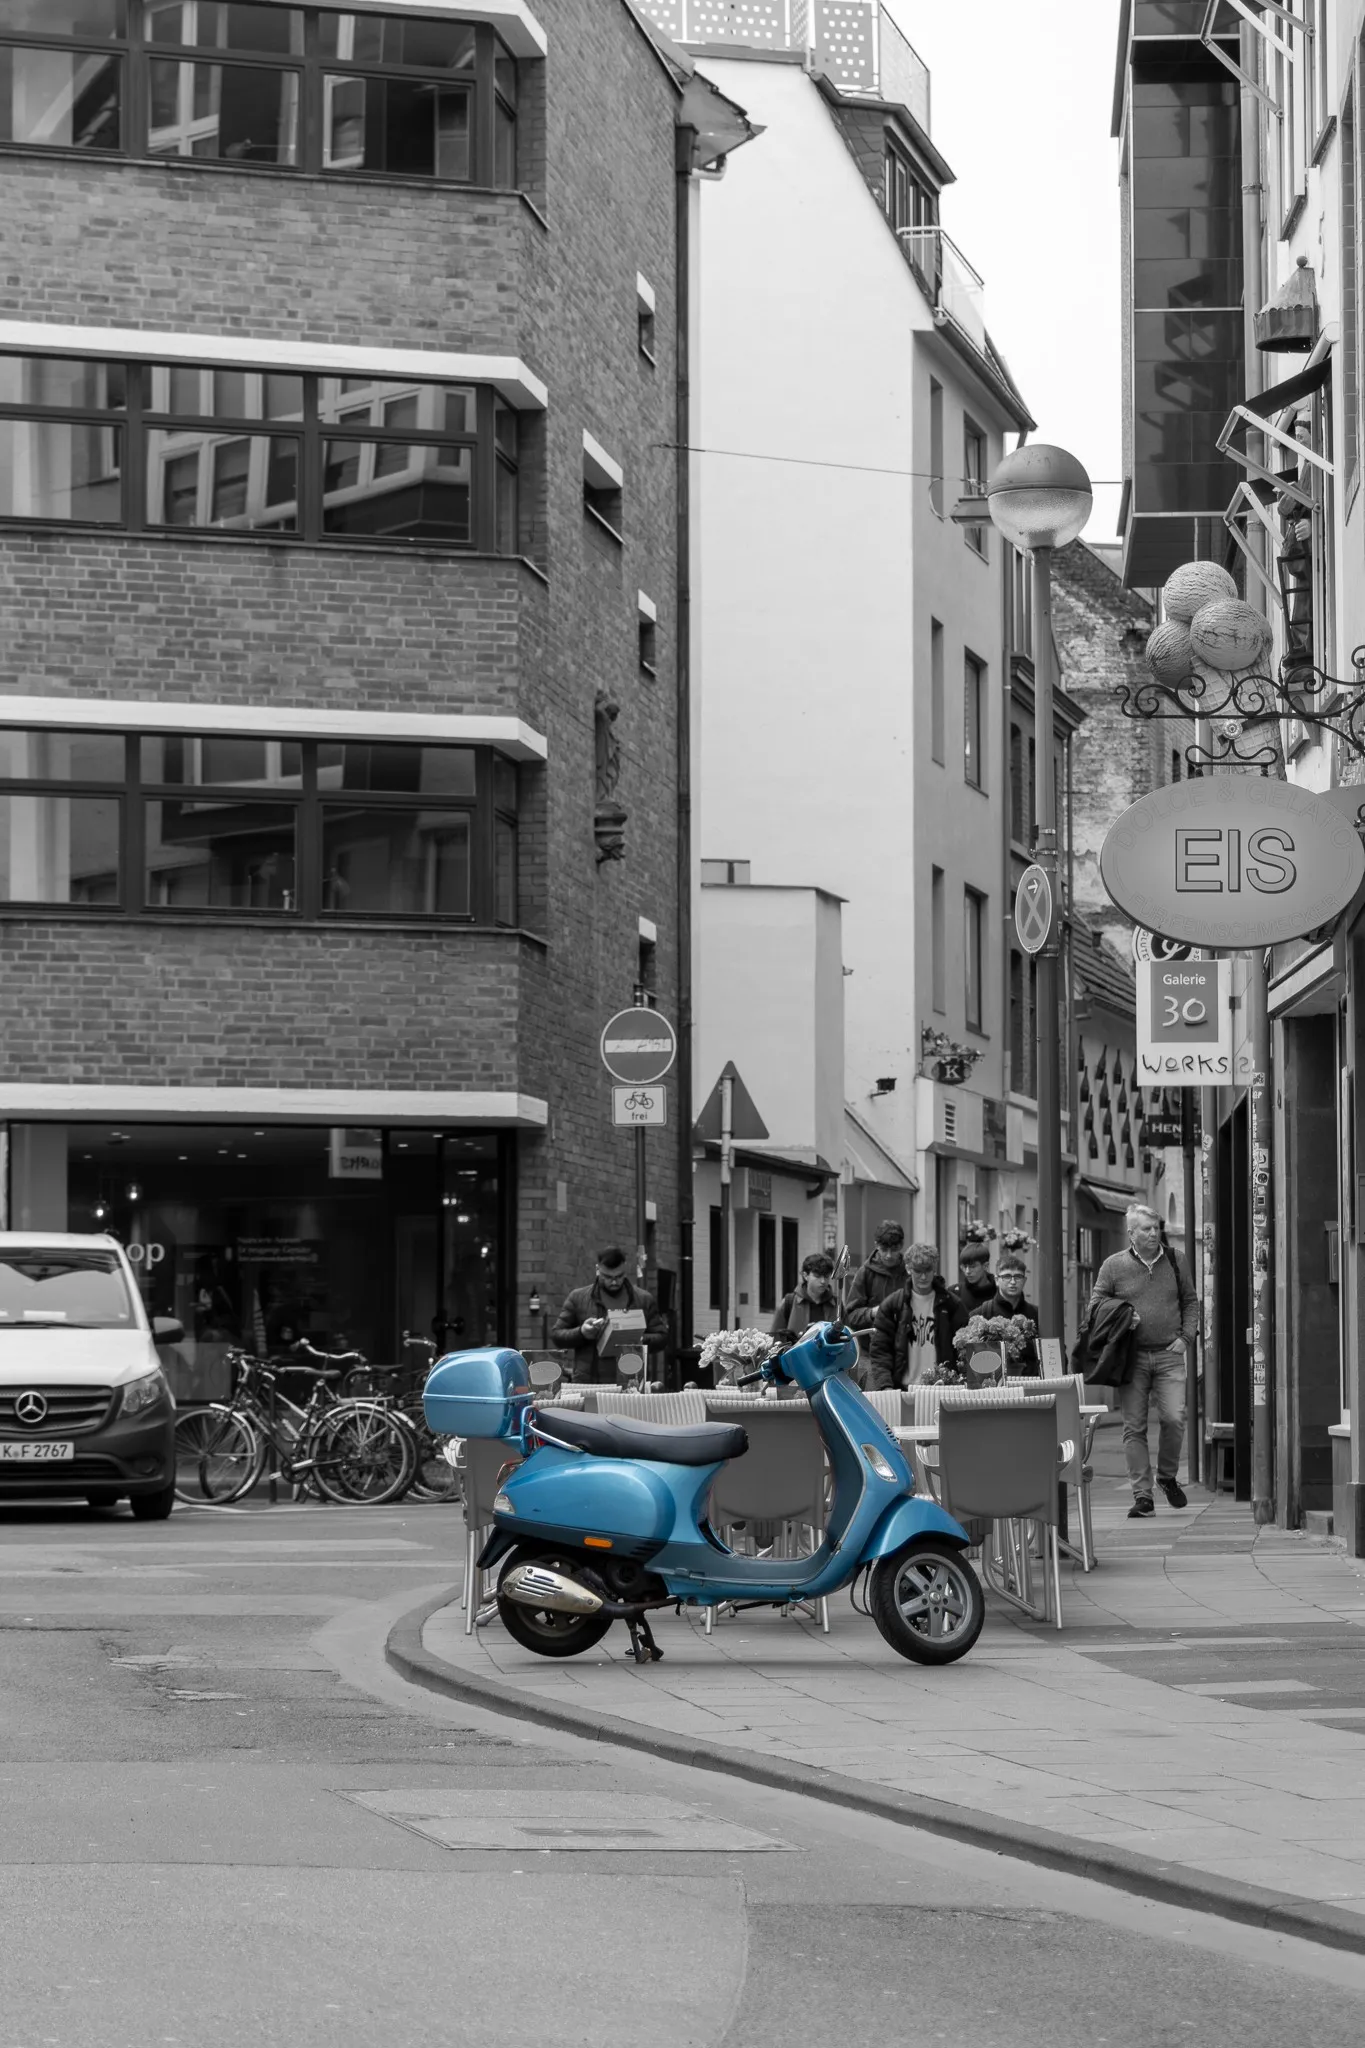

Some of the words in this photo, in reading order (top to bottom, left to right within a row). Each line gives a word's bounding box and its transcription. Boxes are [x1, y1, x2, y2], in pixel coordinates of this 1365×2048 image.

[1113, 780, 1208, 851] DOLCE
[1217, 779, 1236, 803] &
[1245, 780, 1356, 851] GELATO
[1175, 827, 1298, 894] EIS
[1169, 892, 1341, 940] FEINSCHMECKER
[1139, 931, 1151, 962] GLUTE
[1162, 973, 1206, 985] Galerie
[1162, 995, 1207, 1027] 30
[944, 1064, 961, 1079] K
[631, 1111, 649, 1121] frei
[123, 1242, 166, 1271] op
[3, 1444, 13, 1458] K
[21, 1444, 31, 1458] F
[34, 1444, 68, 1458] 2767
